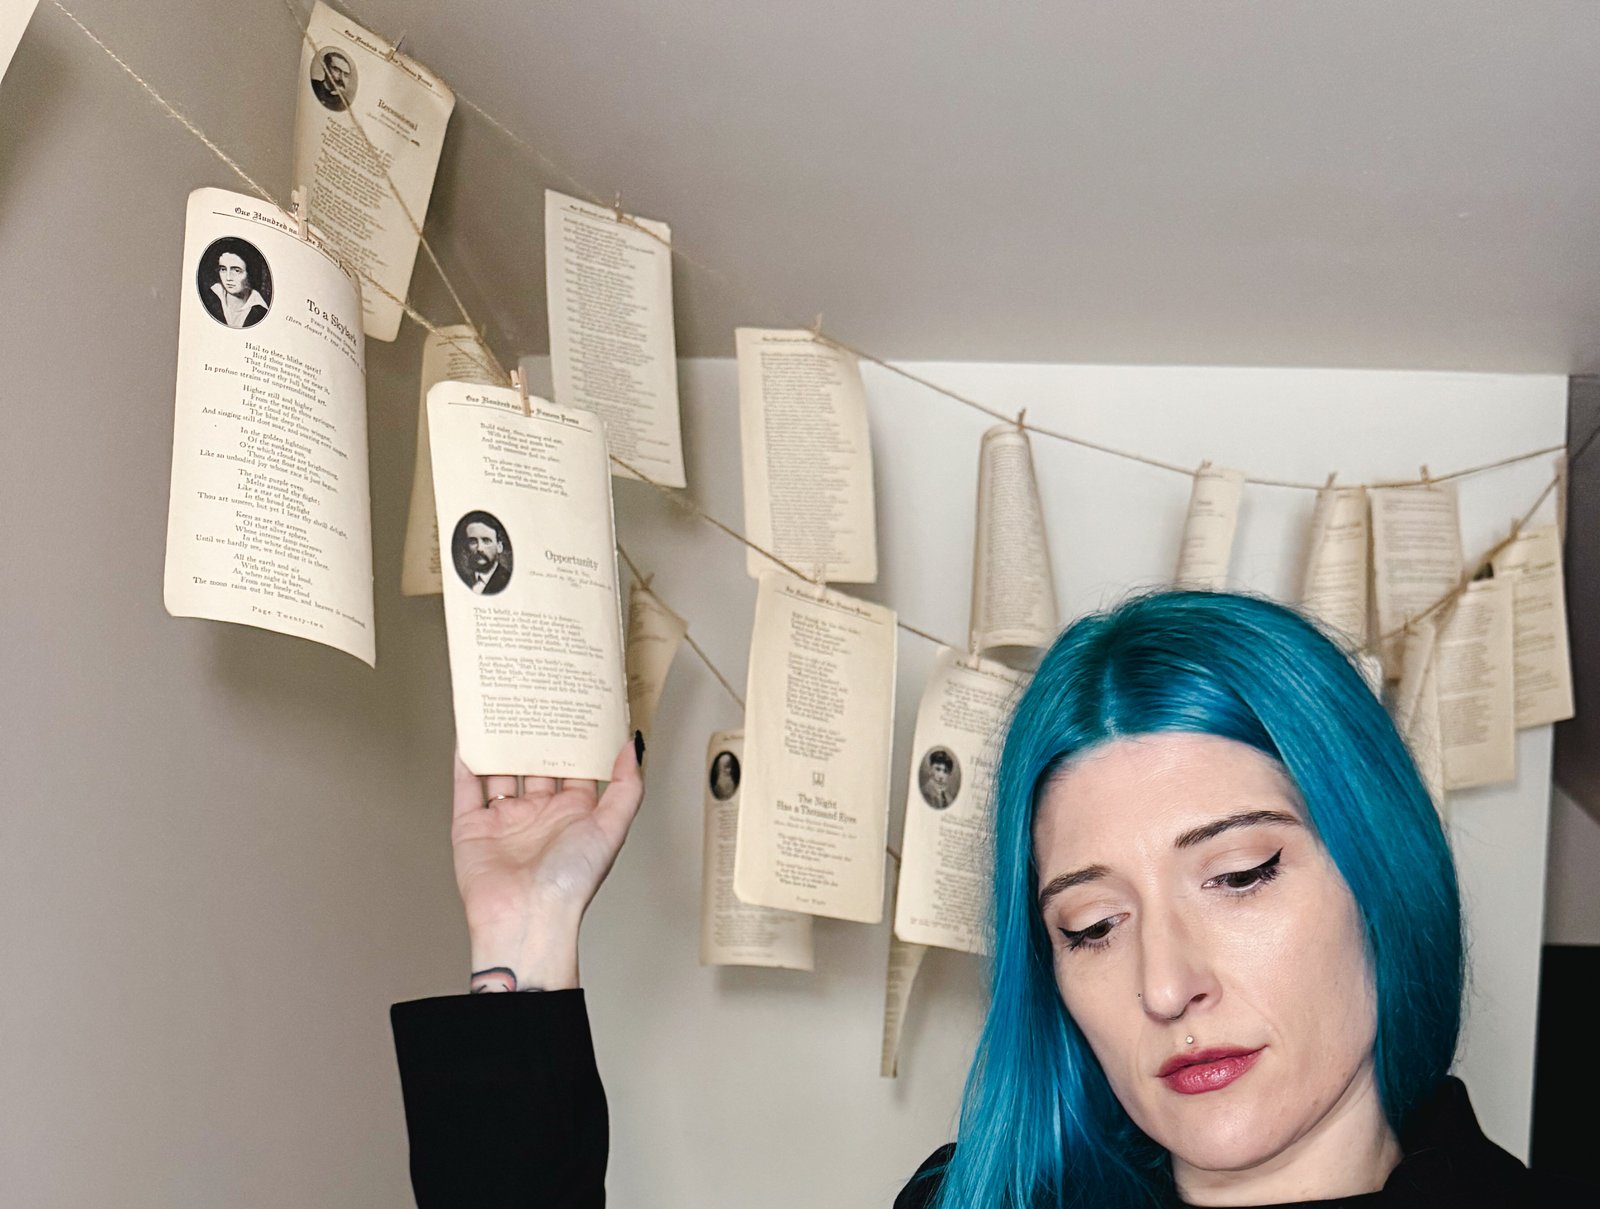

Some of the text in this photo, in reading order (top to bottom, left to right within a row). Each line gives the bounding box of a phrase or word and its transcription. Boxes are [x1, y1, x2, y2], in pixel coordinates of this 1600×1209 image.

[235, 207, 250, 217] One
[253, 211, 287, 230] Hundred
[307, 299, 320, 315] To
[323, 312, 328, 321] a
[245, 342, 260, 352] Hail
[245, 356, 278, 371] That from
[253, 352, 283, 365] Bird thou
[214, 367, 238, 375] profuse
[240, 372, 260, 381] strains
[252, 366, 275, 378] Pourest
[244, 385, 265, 395] Higher
[251, 394, 267, 403] From
[242, 399, 280, 414] Like cloud
[218, 410, 241, 420] singing
[263, 434, 283, 443] golden
[247, 450, 265, 459] Thou
[257, 447, 295, 461] which clouds
[272, 443, 292, 453] sunken
[200, 449, 214, 457] Like
[227, 455, 255, 465] unbodied
[237, 468, 252, 476] The
[269, 477, 288, 486] purple
[238, 483, 252, 491] Like
[247, 477, 288, 493] Melts around
[197, 491, 216, 499] Thou
[288, 510, 299, 519] hear
[267, 497, 284, 506] broad
[236, 510, 252, 520] Keen
[236, 525, 280, 540] Whose intense
[270, 527, 286, 535] silver
[196, 534, 213, 542] Until
[227, 538, 248, 549] hardly
[275, 549, 285, 557] feel
[259, 559, 275, 567] earth
[545, 551, 598, 571] Opportunity
[241, 562, 258, 570] With
[261, 566, 271, 574] thy
[193, 576, 207, 584] The
[245, 571, 280, 583] when night
[241, 576, 258, 585] From
[274, 584, 292, 593] lonely
[252, 606, 324, 628] Page Twenty-two
[798, 793, 837, 809] The Night
[777, 801, 792, 811] Has
[800, 804, 837, 820] Thousand
[839, 812, 856, 824] Eyes
